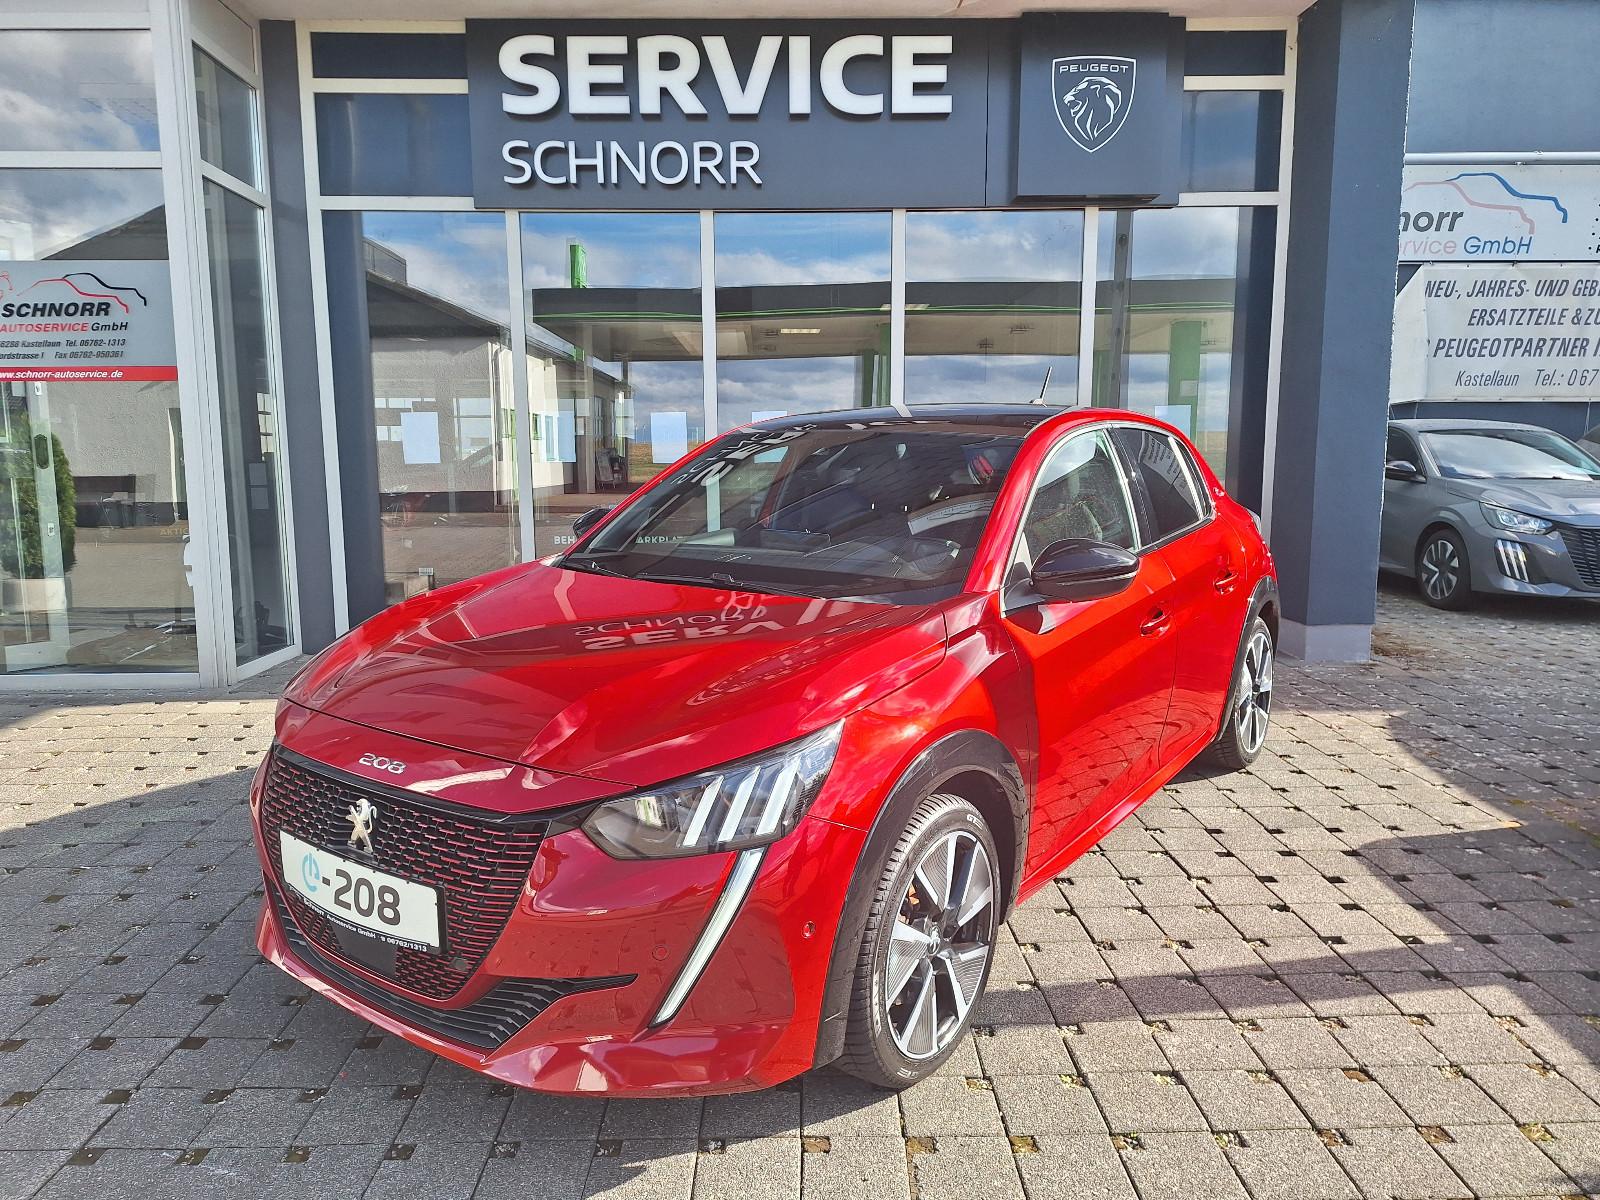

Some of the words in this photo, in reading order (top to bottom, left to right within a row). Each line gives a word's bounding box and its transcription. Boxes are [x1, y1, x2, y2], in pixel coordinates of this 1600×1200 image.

[499, 34, 954, 117] SERVICE
[1059, 63, 1129, 74] PEUGEOT
[502, 140, 763, 187] SCHNORR
[1400, 239, 1457, 256] rvice
[1463, 236, 1533, 255] GmbH
[1466, 279, 1529, 298] JAHRES-
[1534, 279, 1570, 297] UND
[1572, 279, 1600, 297] GEB
[1, 302, 111, 318] SCHNORR
[1467, 308, 1569, 326] ERSATZTEILE
[1571, 307, 1582, 326] &
[0, 323, 89, 333] AUTOSERVICE
[91, 321, 129, 332] GmbH
[0, 340, 19, 348] 6288
[79, 338, 126, 347] 06762-1313
[1433, 337, 1590, 358] PEUGEOTPARTNER
[54, 351, 67, 359] Fax
[1455, 370, 1520, 387] Kastellaun
[358, 752, 407, 775] 208
